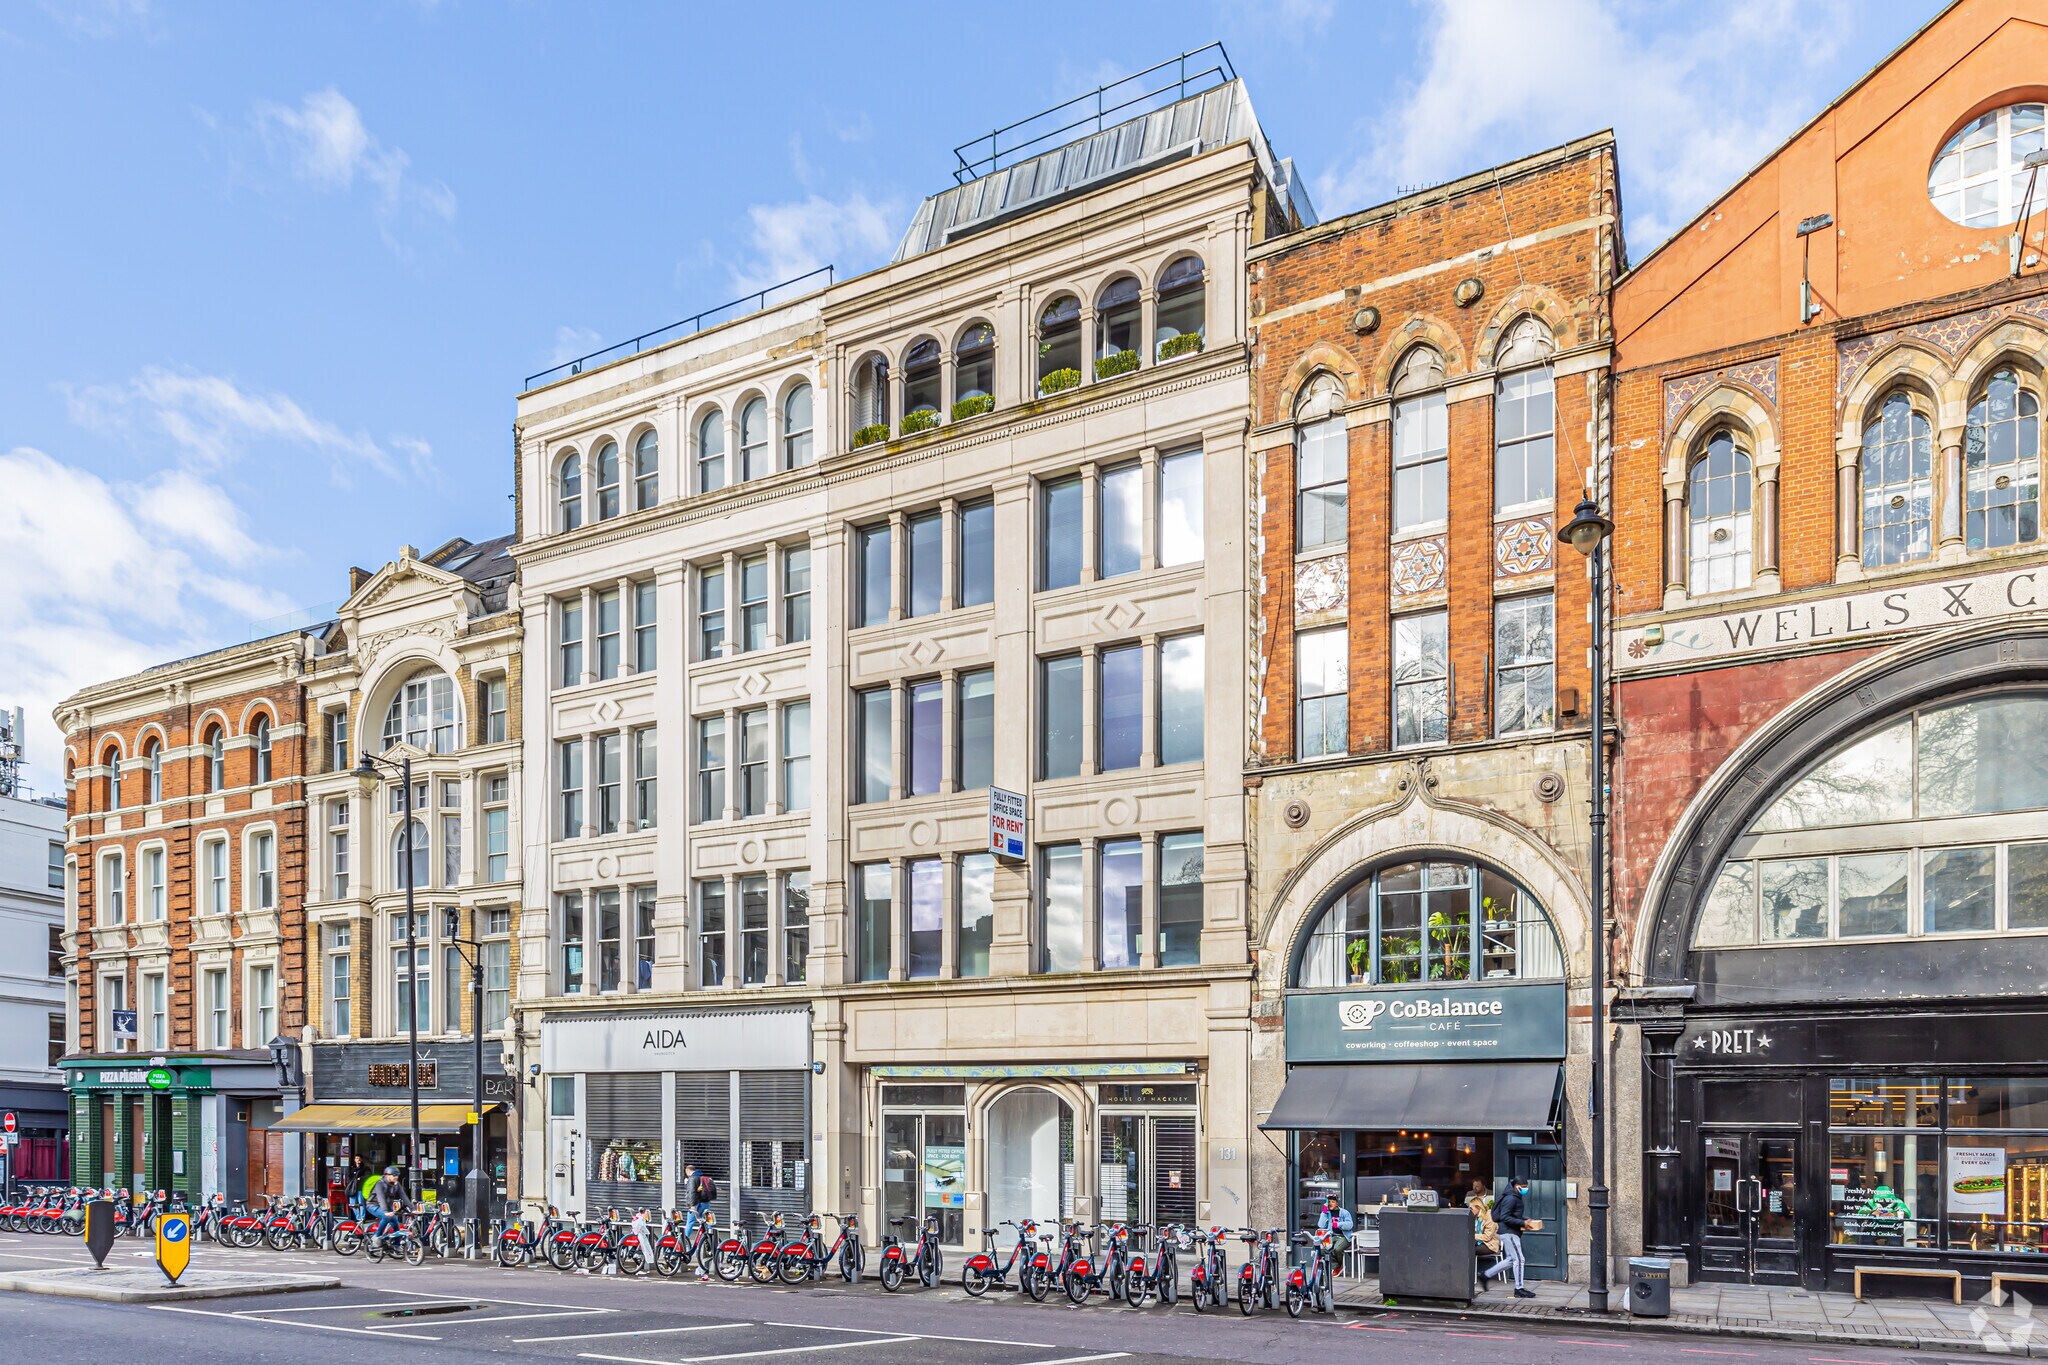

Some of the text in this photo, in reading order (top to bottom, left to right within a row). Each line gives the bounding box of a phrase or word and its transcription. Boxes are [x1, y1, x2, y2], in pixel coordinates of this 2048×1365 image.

[1723, 593, 1910, 649] WELLS
[1942, 582, 1974, 618] &
[993, 791, 1022, 808] FULLY FITTED
[993, 802, 1023, 818] OFFICE SPACE
[992, 815, 1023, 834] FOR RENT
[1389, 998, 1503, 1018] CoBalance
[1429, 1020, 1461, 1031] CAFÉ
[642, 1029, 687, 1049] AIDA
[1345, 1039, 1498, 1049] coworking coffeeshop event space
[1711, 1029, 1754, 1054] PRET
[100, 1068, 149, 1083] PIZZA PILGRIM
[367, 1063, 408, 1086] MATCH
[485, 1079, 515, 1098] BAR
[1219, 1147, 1236, 1160] 131
